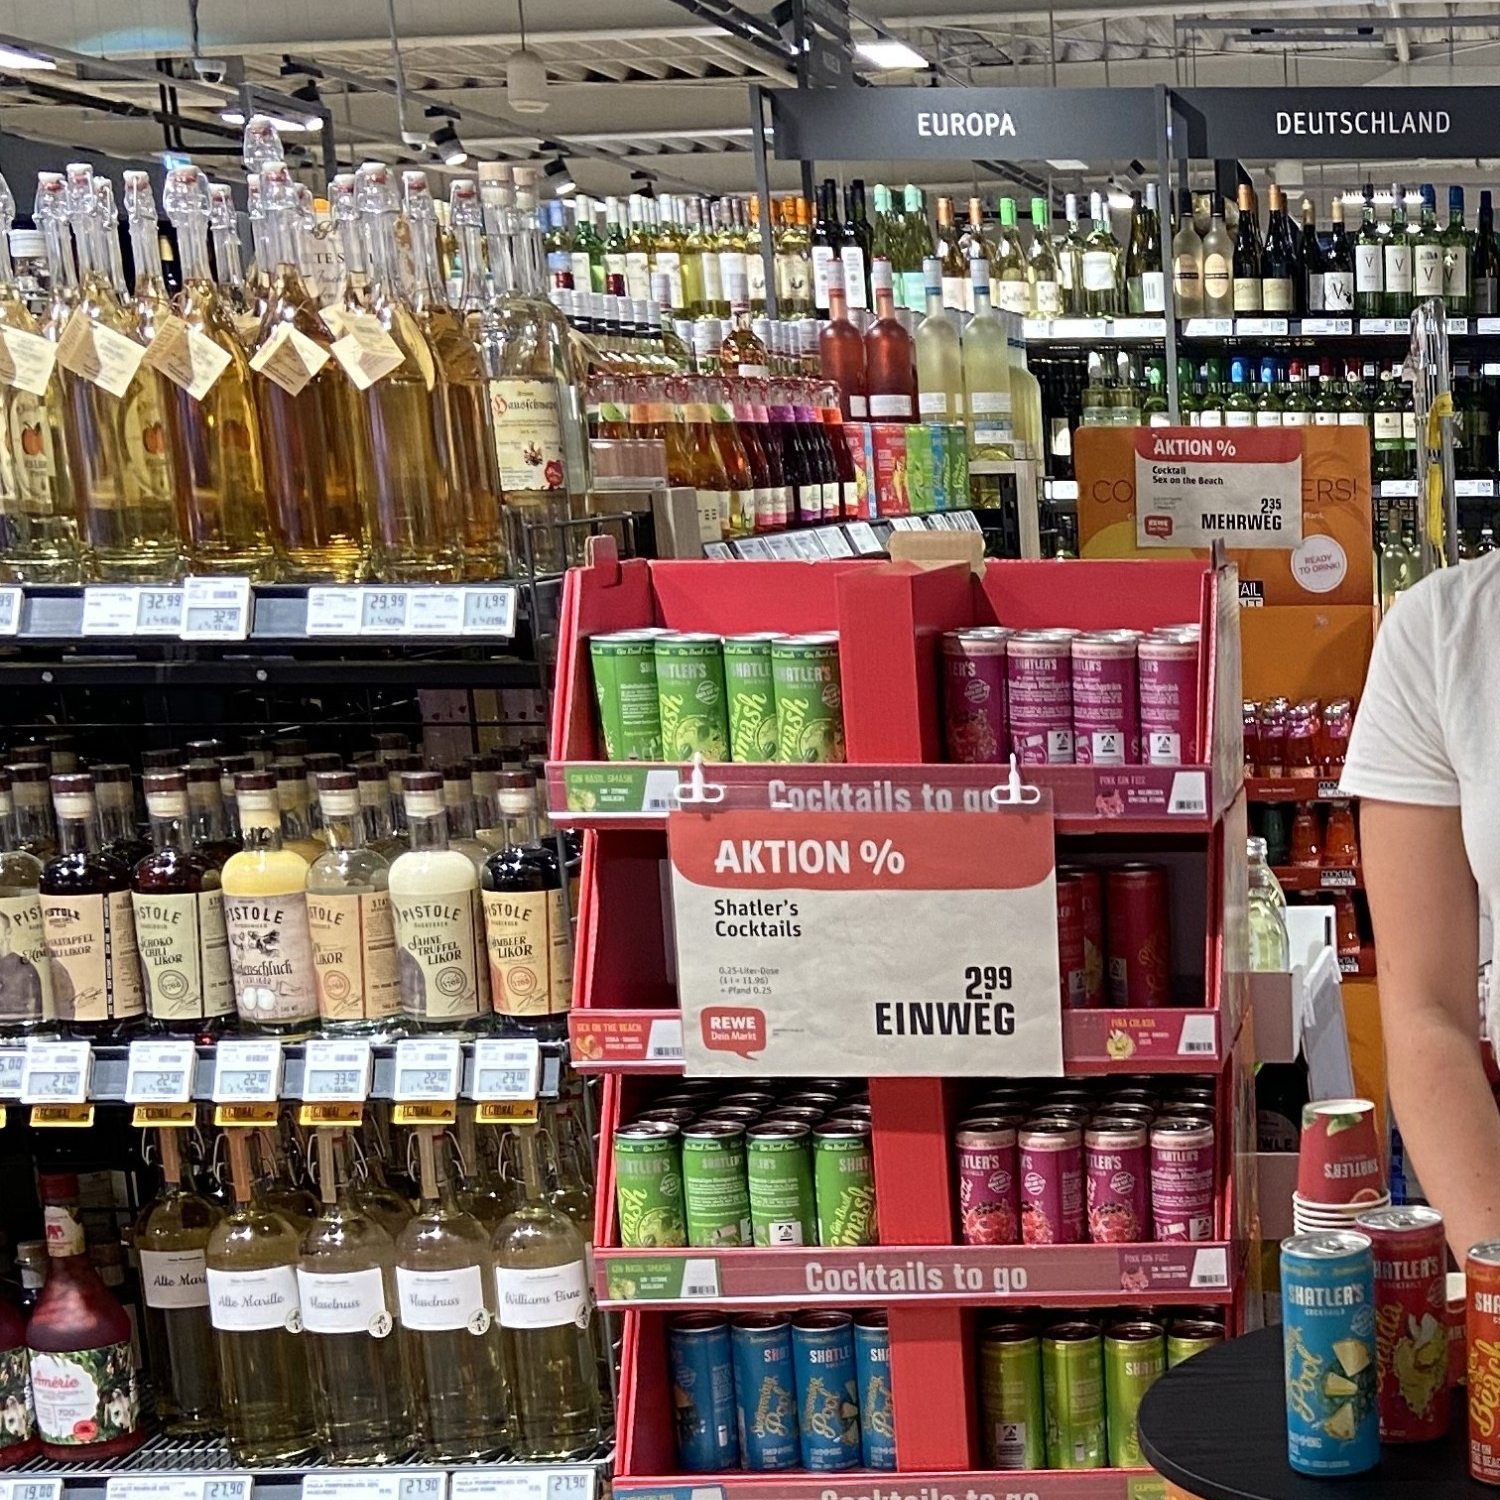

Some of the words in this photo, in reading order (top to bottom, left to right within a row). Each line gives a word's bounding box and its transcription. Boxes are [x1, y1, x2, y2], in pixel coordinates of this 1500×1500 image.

[917, 112, 1017, 137] EUROPA
[1275, 109, 1452, 137] DEUTSCHLAND
[1153, 439, 1213, 457] AKTION
[1216, 440, 1237, 457] %
[1152, 466, 1186, 475] Cocktail
[1152, 476, 1168, 485] Sex
[1170, 477, 1180, 485] on
[1182, 476, 1196, 485] the
[1198, 476, 1224, 486] Beach
[1201, 513, 1282, 531] MEHRWEG
[1304, 554, 1333, 566] READY
[1299, 565, 1311, 576] TO
[1312, 562, 1342, 574] DRINK!
[768, 779, 911, 812] Cocktails
[922, 783, 952, 812] to
[714, 840, 851, 875] AKTION
[860, 838, 905, 875] %
[402, 904, 462, 923] PISTOLE
[714, 899, 799, 918] Shatler's
[715, 920, 802, 939] Cocktails
[140, 936, 174, 952] SCHOKO
[719, 966, 779, 976] 0.25-Liter-Dose
[728, 986, 752, 995] Pfand
[753, 986, 772, 995] 0.25
[710, 1016, 756, 1030] REWE
[875, 1001, 1016, 1037] EINWEG
[711, 1030, 729, 1041] Dein
[731, 1030, 757, 1041] Markt
[1323, 1157, 1379, 1179] SHATLER'S
[154, 1275, 175, 1287] Alte
[805, 1259, 945, 1292] Cocktails
[953, 1263, 983, 1290] to
[993, 1266, 1028, 1294] go
[218, 1295, 239, 1308] Alte
[243, 1293, 285, 1308] Marille
[309, 1296, 361, 1310] Haselnuss
[408, 1294, 460, 1308] Haselnuss
[505, 1290, 551, 1305] Williams
[554, 1288, 582, 1302] Birne
[1287, 1283, 1365, 1307] SHATLER'S
[1304, 1307, 1346, 1317] COCKTAILS
[211, 1482, 243, 1498] 27.90
[406, 1479, 438, 1494] 27.90
[555, 1475, 586, 1491] 27.90
